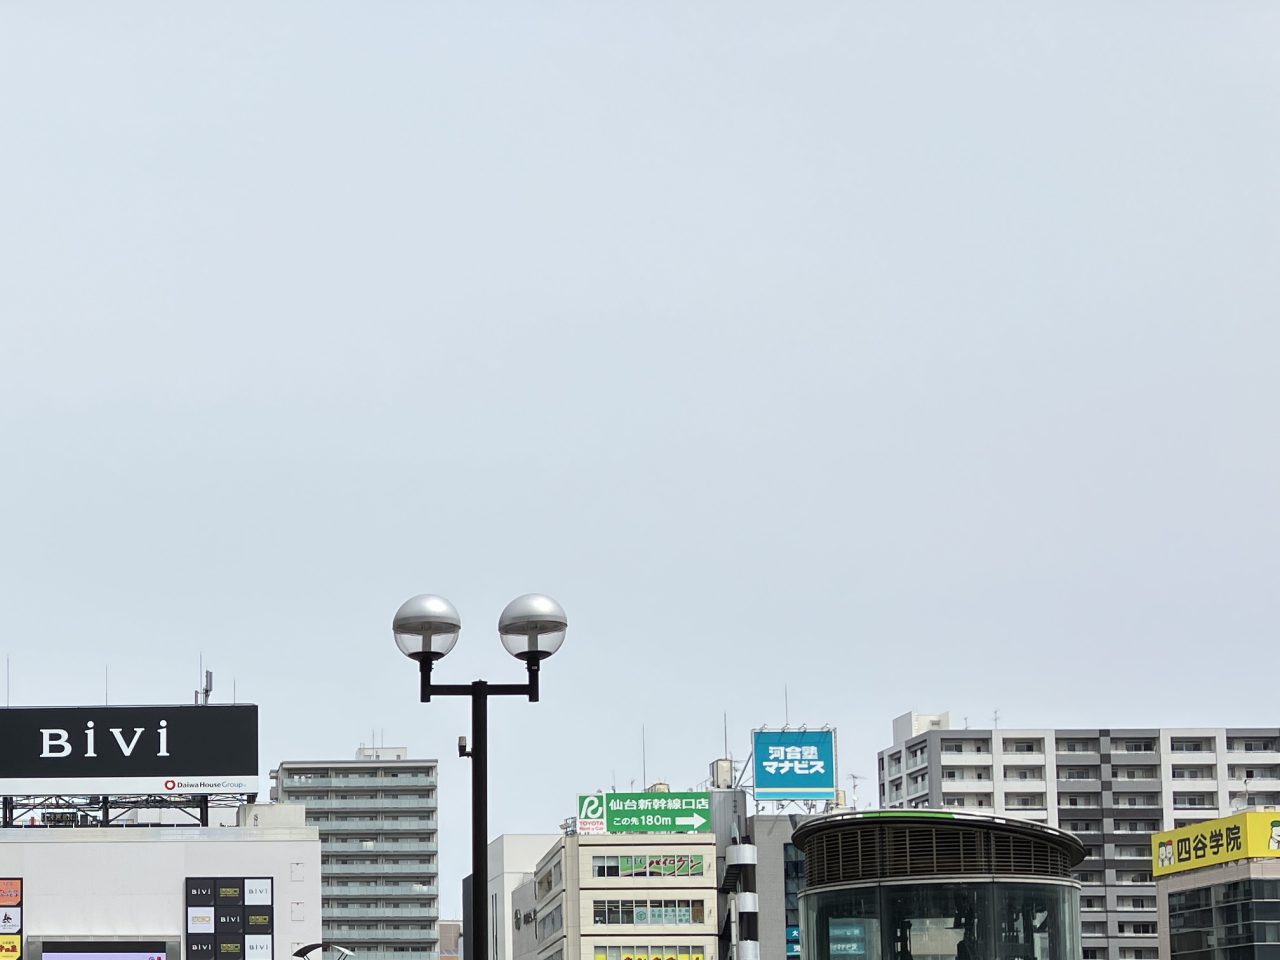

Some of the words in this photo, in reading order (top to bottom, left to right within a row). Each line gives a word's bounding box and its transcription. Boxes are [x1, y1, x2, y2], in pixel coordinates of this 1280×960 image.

[39, 719, 170, 758] BiVi
[768, 745, 818, 760] 河合塾
[762, 760, 825, 774] マナビス
[177, 781, 200, 789] Daiwa
[200, 781, 222, 789] House
[222, 781, 243, 790] Group
[609, 798, 709, 811] 仙台新幹線口店
[1177, 825, 1242, 863] 四谷学院
